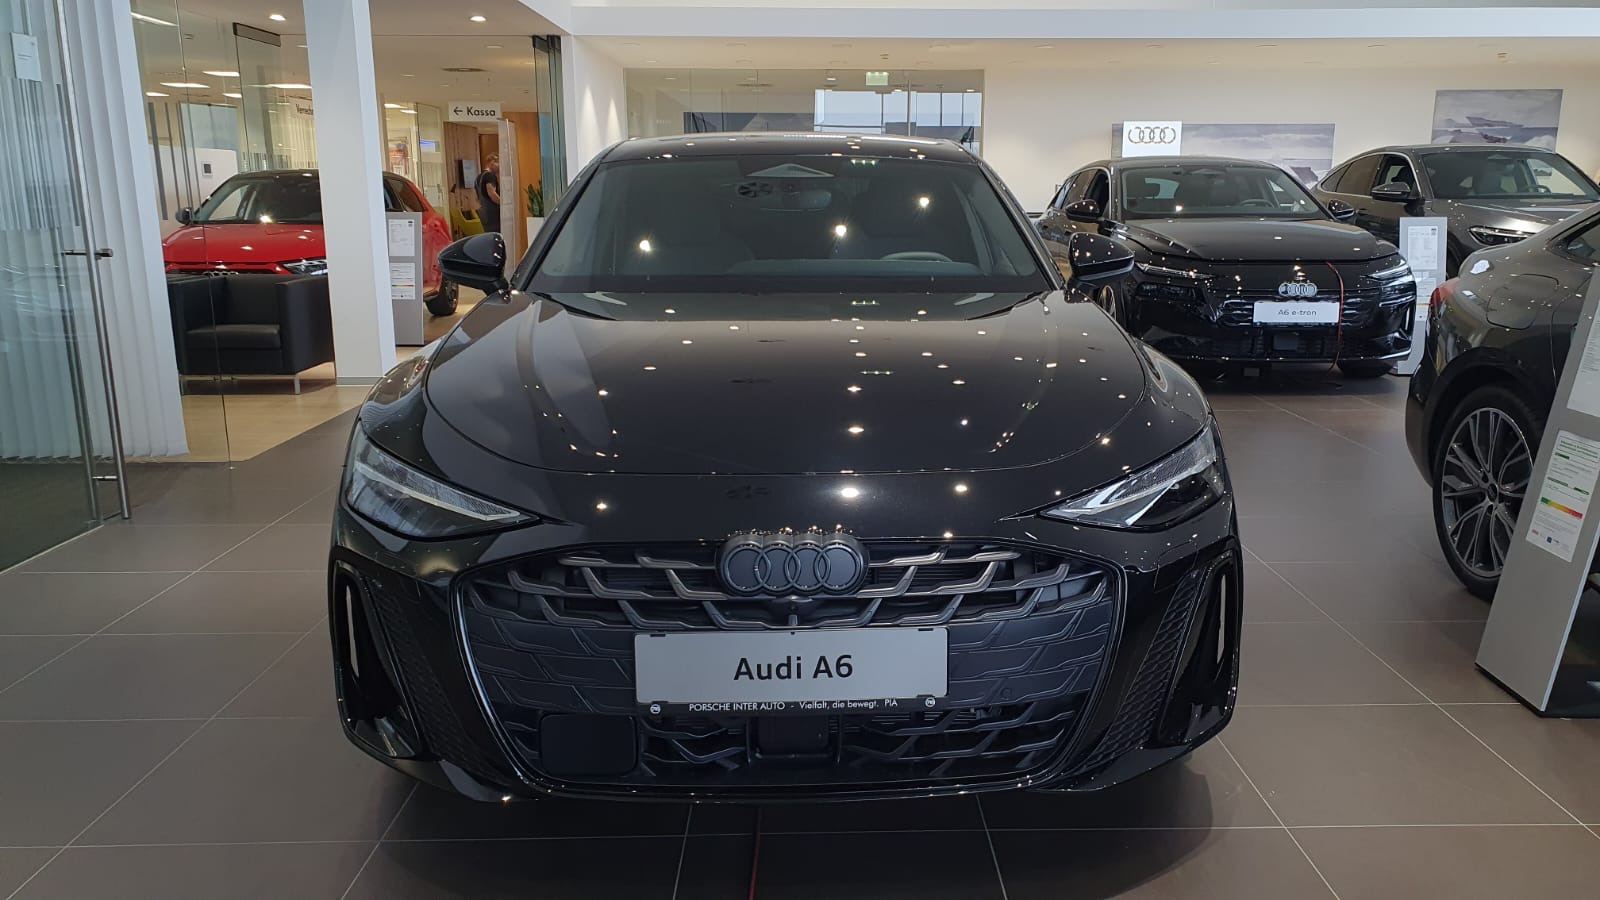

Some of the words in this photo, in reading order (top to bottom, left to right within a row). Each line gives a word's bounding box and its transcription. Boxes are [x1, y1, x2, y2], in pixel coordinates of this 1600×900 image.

[466, 106, 496, 117] Kassa
[733, 655, 802, 681] Audi
[812, 654, 854, 679] A6
[689, 703, 731, 712] PORSCHE
[733, 702, 759, 711] INTER
[760, 701, 786, 710] AUTO
[799, 700, 831, 710] Vielfalt,
[832, 700, 846, 709] die
[847, 699, 880, 709] bewegt.
[884, 698, 899, 707] PIA
